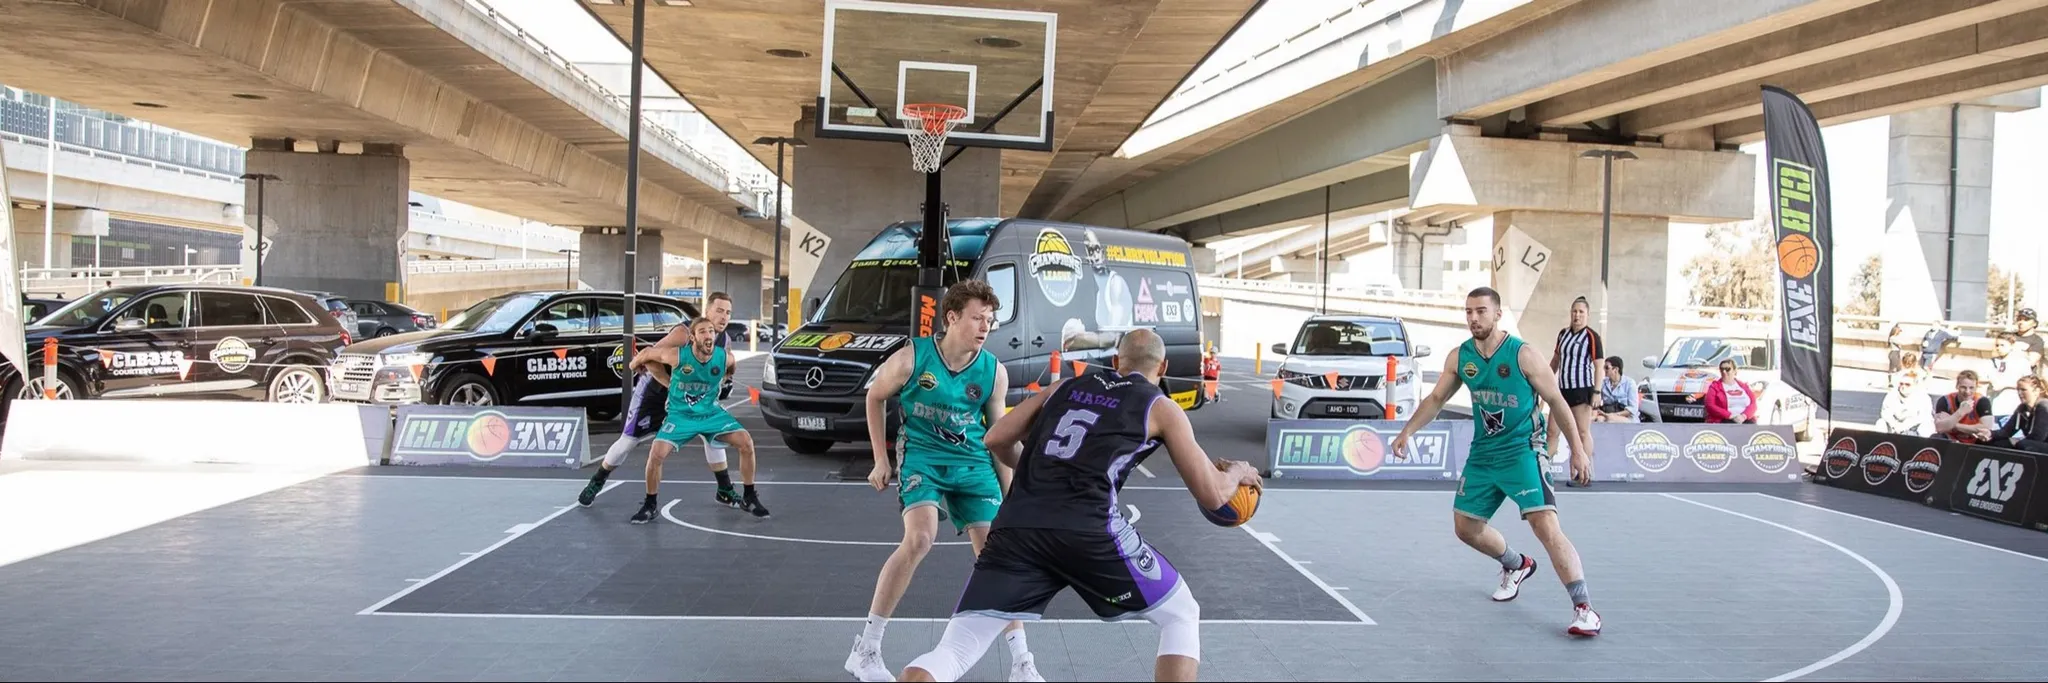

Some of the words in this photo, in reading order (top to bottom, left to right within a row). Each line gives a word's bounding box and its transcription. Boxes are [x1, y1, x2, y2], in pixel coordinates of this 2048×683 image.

[1779, 166, 1812, 233] CLB
[799, 231, 826, 258] K2
[1029, 252, 1081, 276] CHAMPIONS
[1493, 246, 1506, 272] L2
[1521, 245, 1546, 272] L2
[1042, 270, 1073, 281] LEAGUE
[1134, 303, 1159, 322] PEAK
[1787, 279, 1817, 346] 3X3
[527, 356, 587, 372] CLB3X3
[527, 372, 560, 380] COURTESY
[561, 371, 587, 379] VEHICLE
[403, 420, 467, 448] CLB
[509, 422, 572, 450] 3X3
[1045, 409, 1100, 459] 5
[1282, 435, 1340, 463] CLB
[1627, 443, 1677, 456] CHAMPIONS
[1685, 444, 1736, 457] CHAMPIONS
[1743, 444, 1794, 457] CHAMPIONS
[1966, 458, 2025, 501] 3X3
